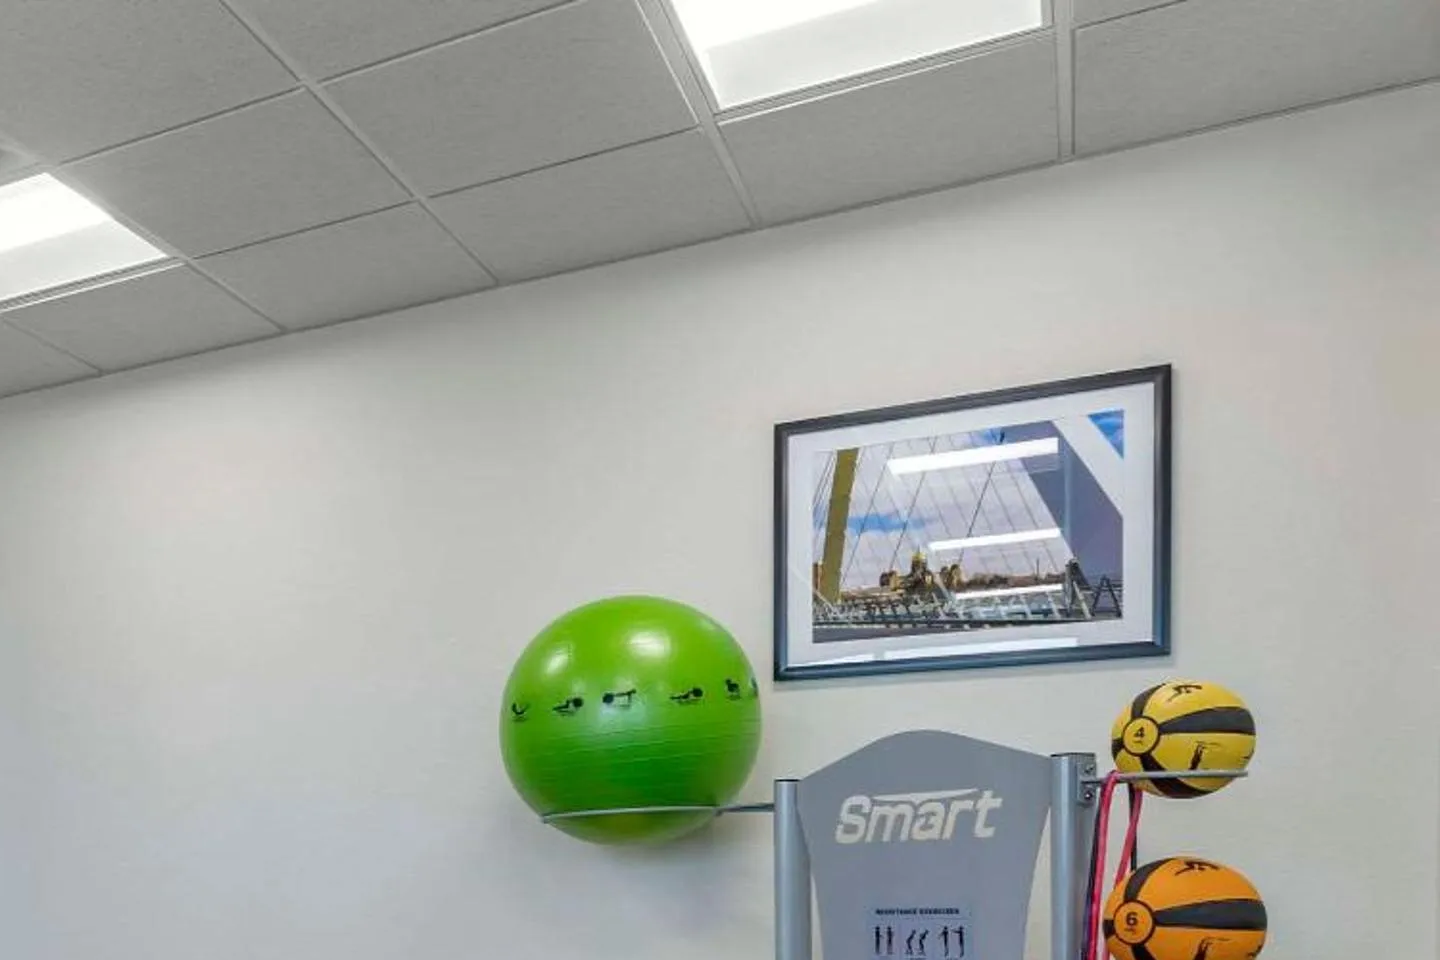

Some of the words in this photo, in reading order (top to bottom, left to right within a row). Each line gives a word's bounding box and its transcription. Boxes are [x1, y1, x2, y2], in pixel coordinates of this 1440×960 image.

[1132, 726, 1145, 738] 4
[835, 788, 1003, 844] Smart
[1126, 911, 1138, 926] 6
